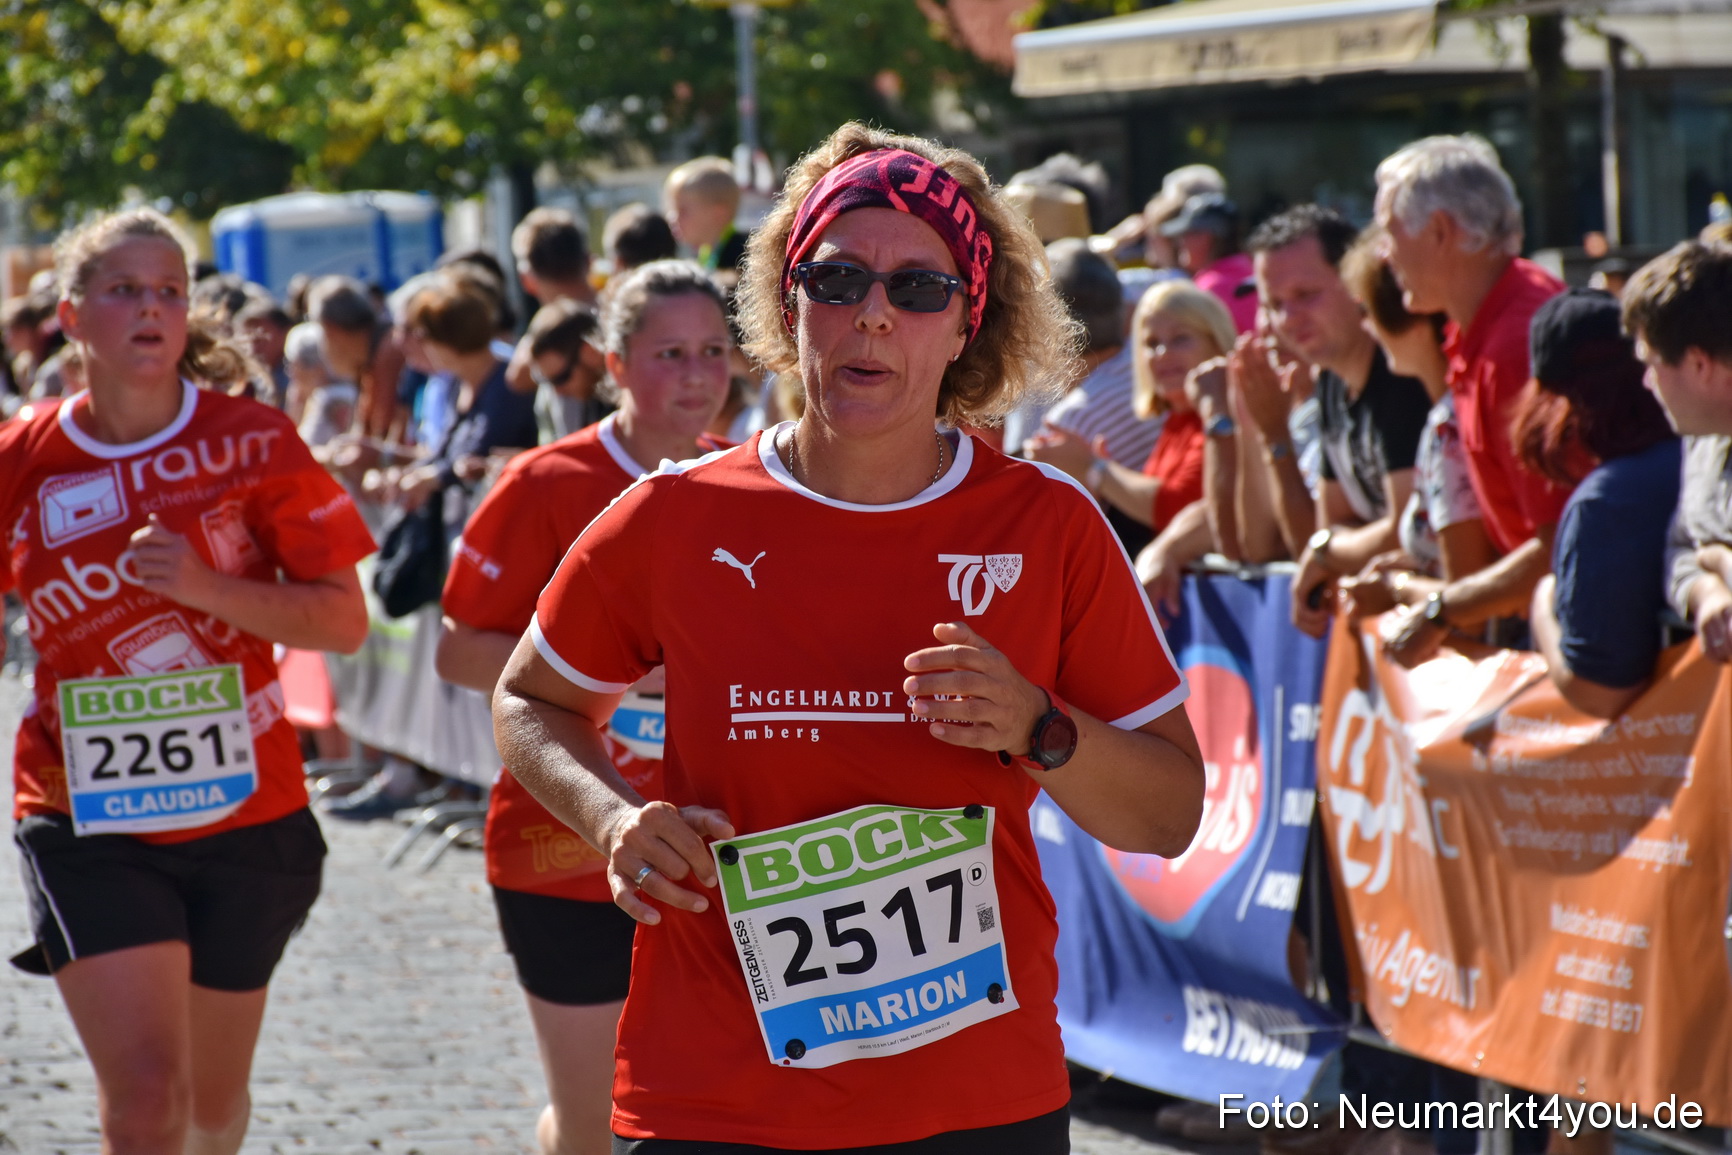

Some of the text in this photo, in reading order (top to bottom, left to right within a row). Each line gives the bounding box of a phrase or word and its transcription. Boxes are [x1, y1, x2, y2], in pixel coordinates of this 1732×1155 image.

[76, 675, 229, 721] BOCK
[730, 684, 894, 708] ENGELHARDT
[86, 724, 227, 781] 2261
[727, 725, 820, 742] Amberg
[104, 785, 227, 817] CLAUDIA
[742, 812, 968, 896] BOCK
[972, 867, 982, 881] D
[766, 868, 964, 987] 2517
[819, 970, 967, 1035] MARION
